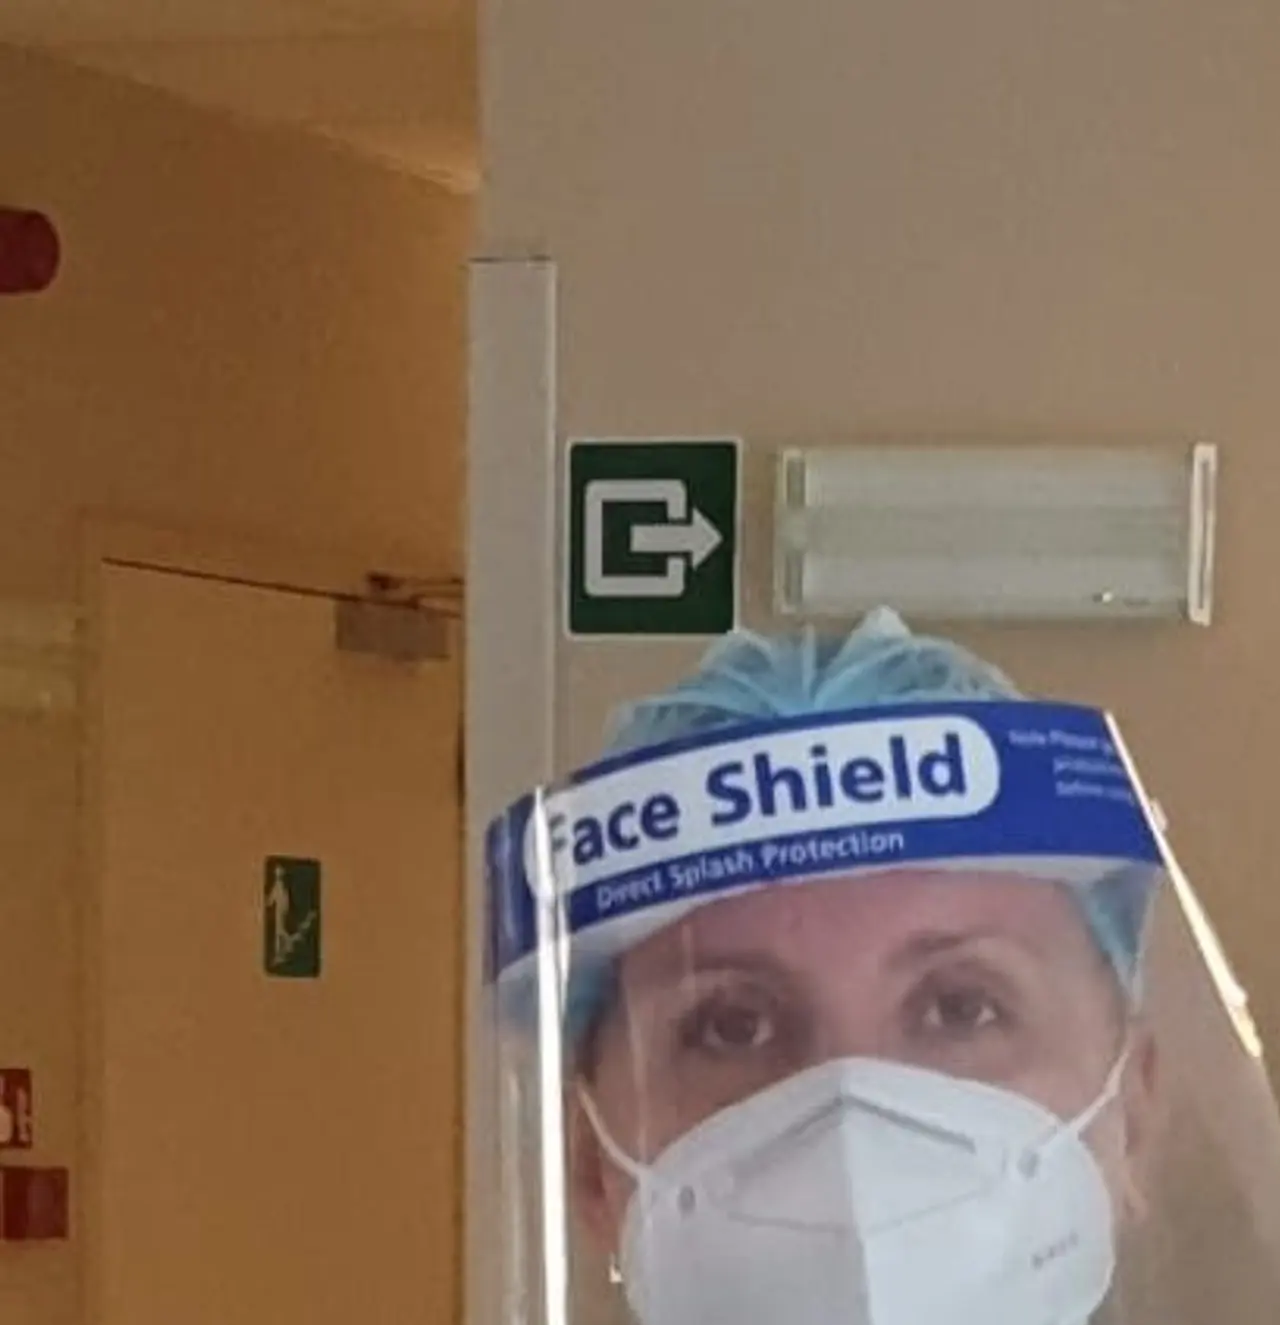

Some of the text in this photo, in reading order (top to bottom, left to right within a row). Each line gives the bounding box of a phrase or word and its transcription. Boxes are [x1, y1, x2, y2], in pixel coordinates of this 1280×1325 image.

[705, 731, 967, 826] Shield
[595, 832, 905, 911] Direct Splash Protection
